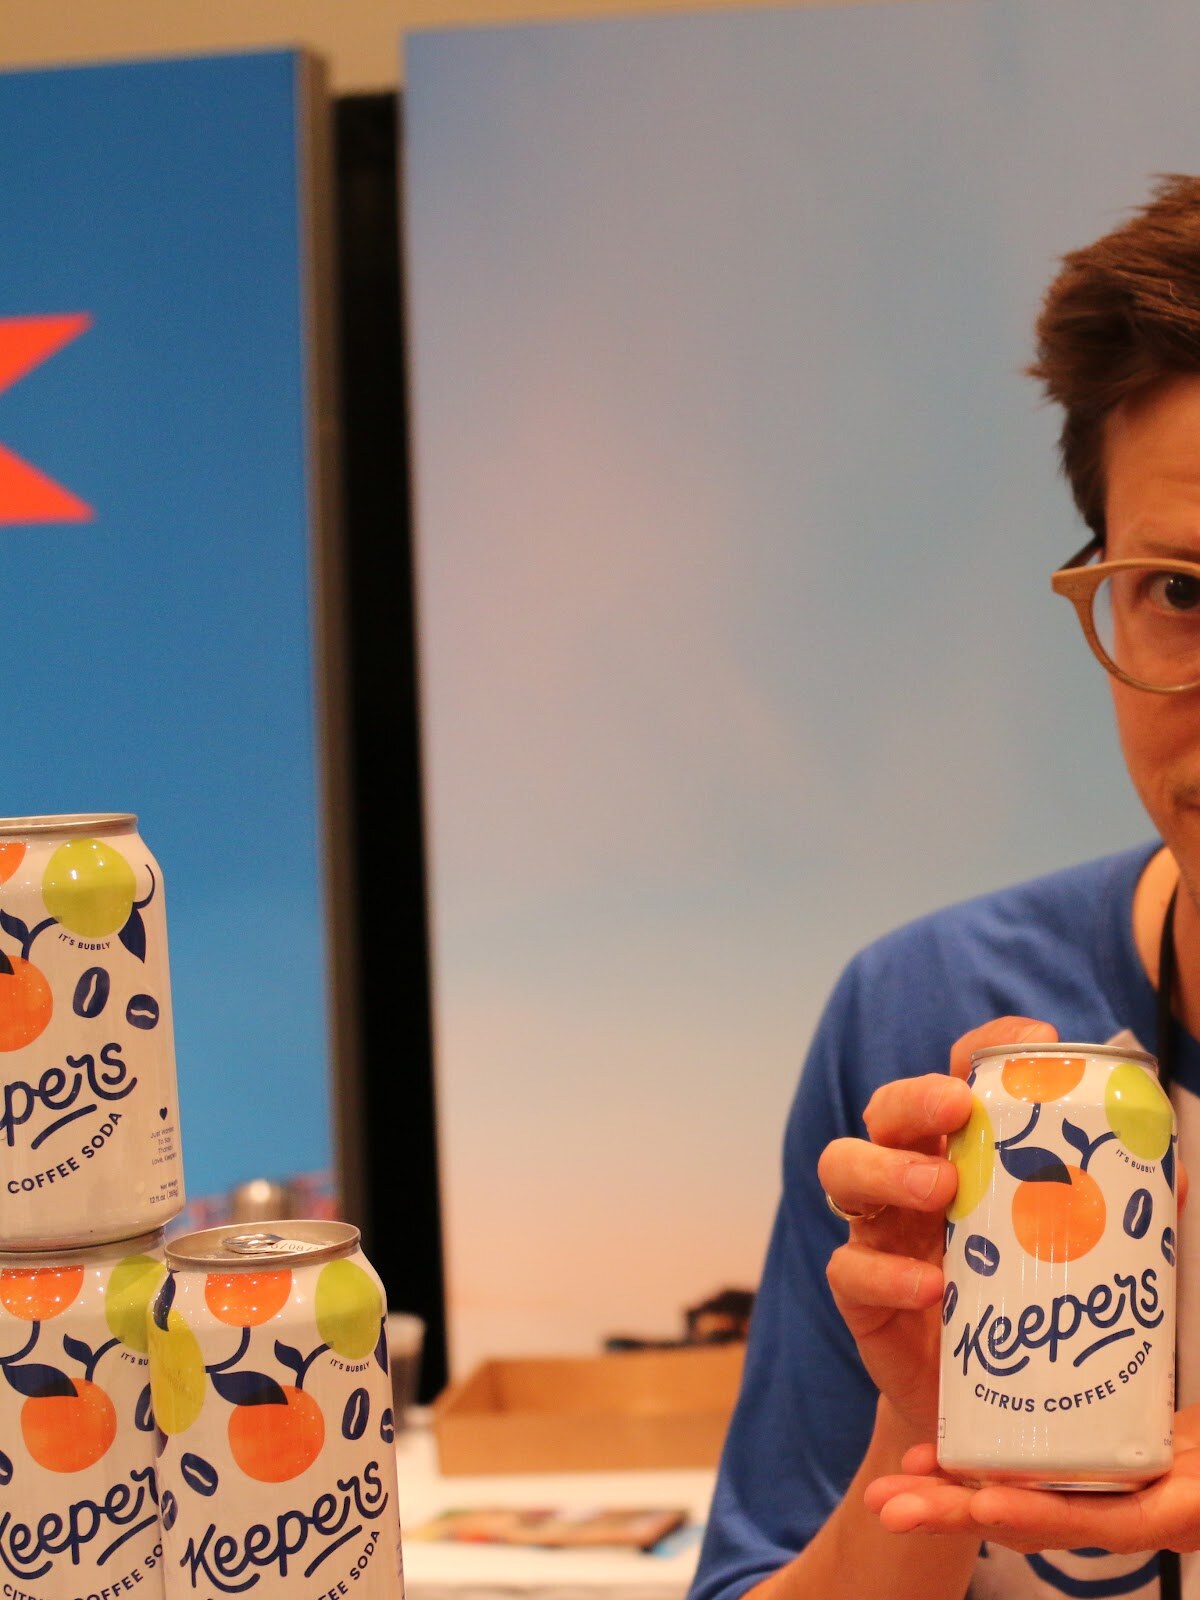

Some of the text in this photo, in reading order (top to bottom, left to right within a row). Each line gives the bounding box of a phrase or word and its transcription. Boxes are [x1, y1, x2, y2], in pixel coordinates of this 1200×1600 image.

[58, 933, 111, 951] IT'S BUBBLY
[0, 1042, 138, 1147] pers
[7, 1112, 123, 1194] COFFEE SODA
[1115, 1149, 1156, 1173] IT'S BUBBLY
[953, 1268, 1165, 1377] Keepers
[121, 1352, 136, 1364] IT'S
[330, 1358, 370, 1373] IT'S BUBBLY
[974, 1340, 1153, 1413] CITRUS COFFEE SODA
[0, 1466, 159, 1580] Keeper
[144, 1538, 163, 1569] SO
[179, 1461, 389, 1594] Keepers
[350, 1530, 381, 1581] SODA
